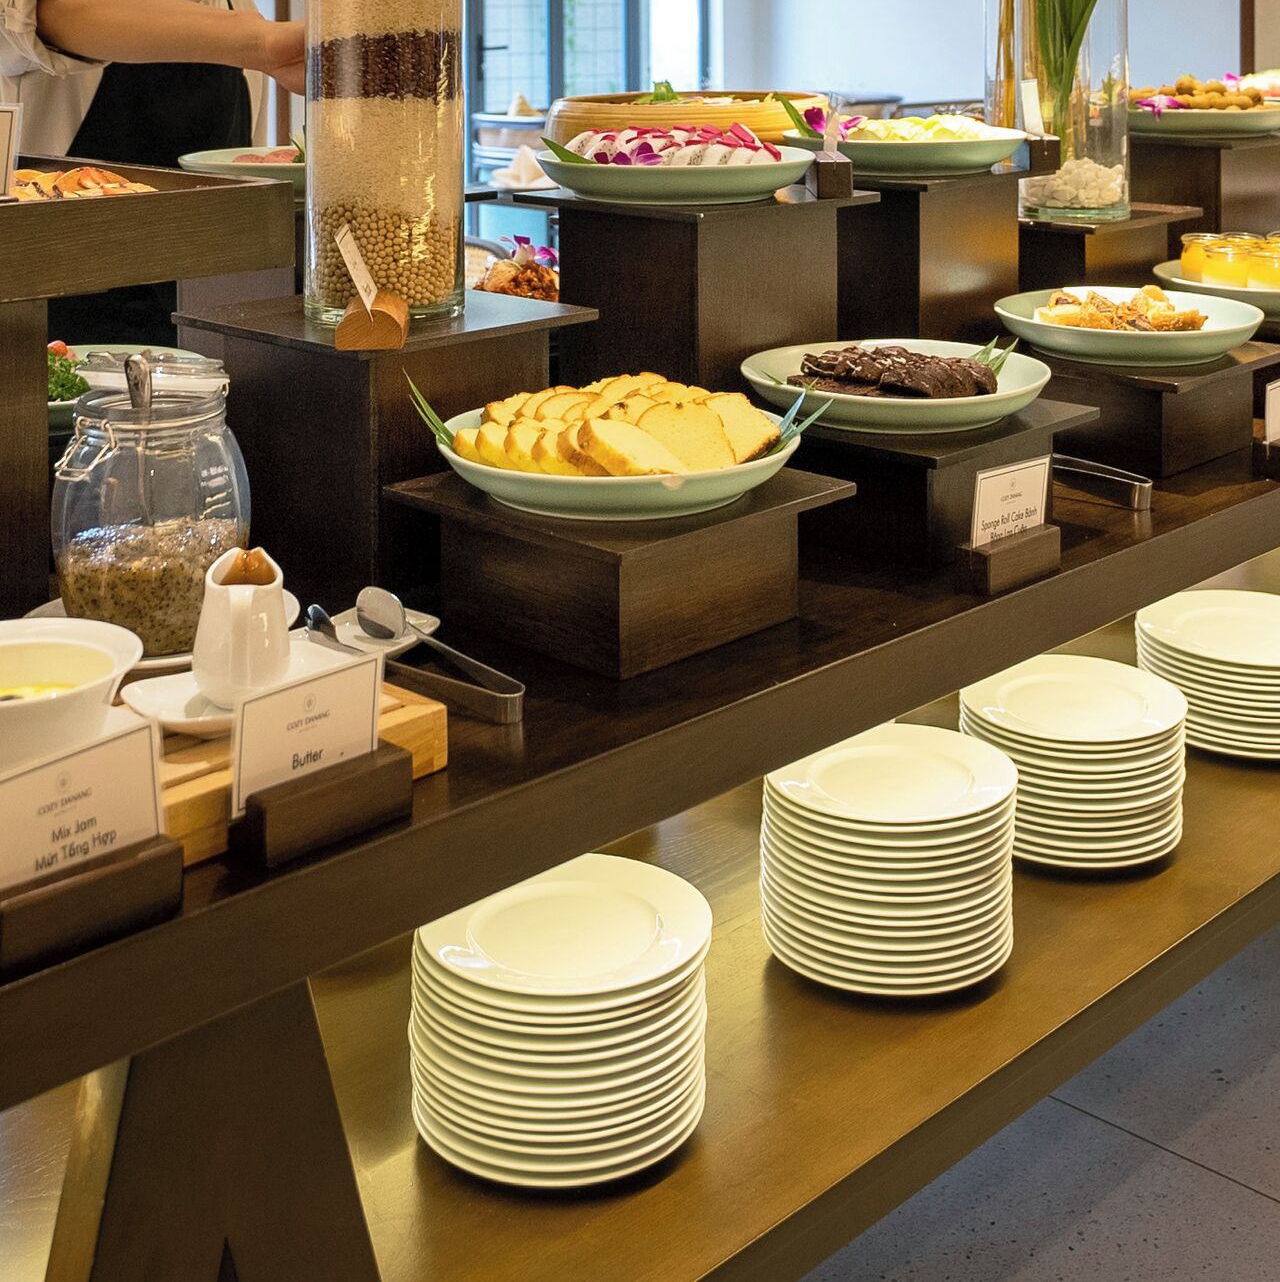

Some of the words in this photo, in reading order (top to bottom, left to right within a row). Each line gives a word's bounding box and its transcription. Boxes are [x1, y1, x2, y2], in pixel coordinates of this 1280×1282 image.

[980, 519, 1000, 532] Sponge
[1001, 513, 1010, 525] Roll
[1011, 510, 1024, 522] Cake
[292, 749, 323, 770] Butter
[51, 825, 71, 842] Mix
[75, 817, 96, 833] Jam
